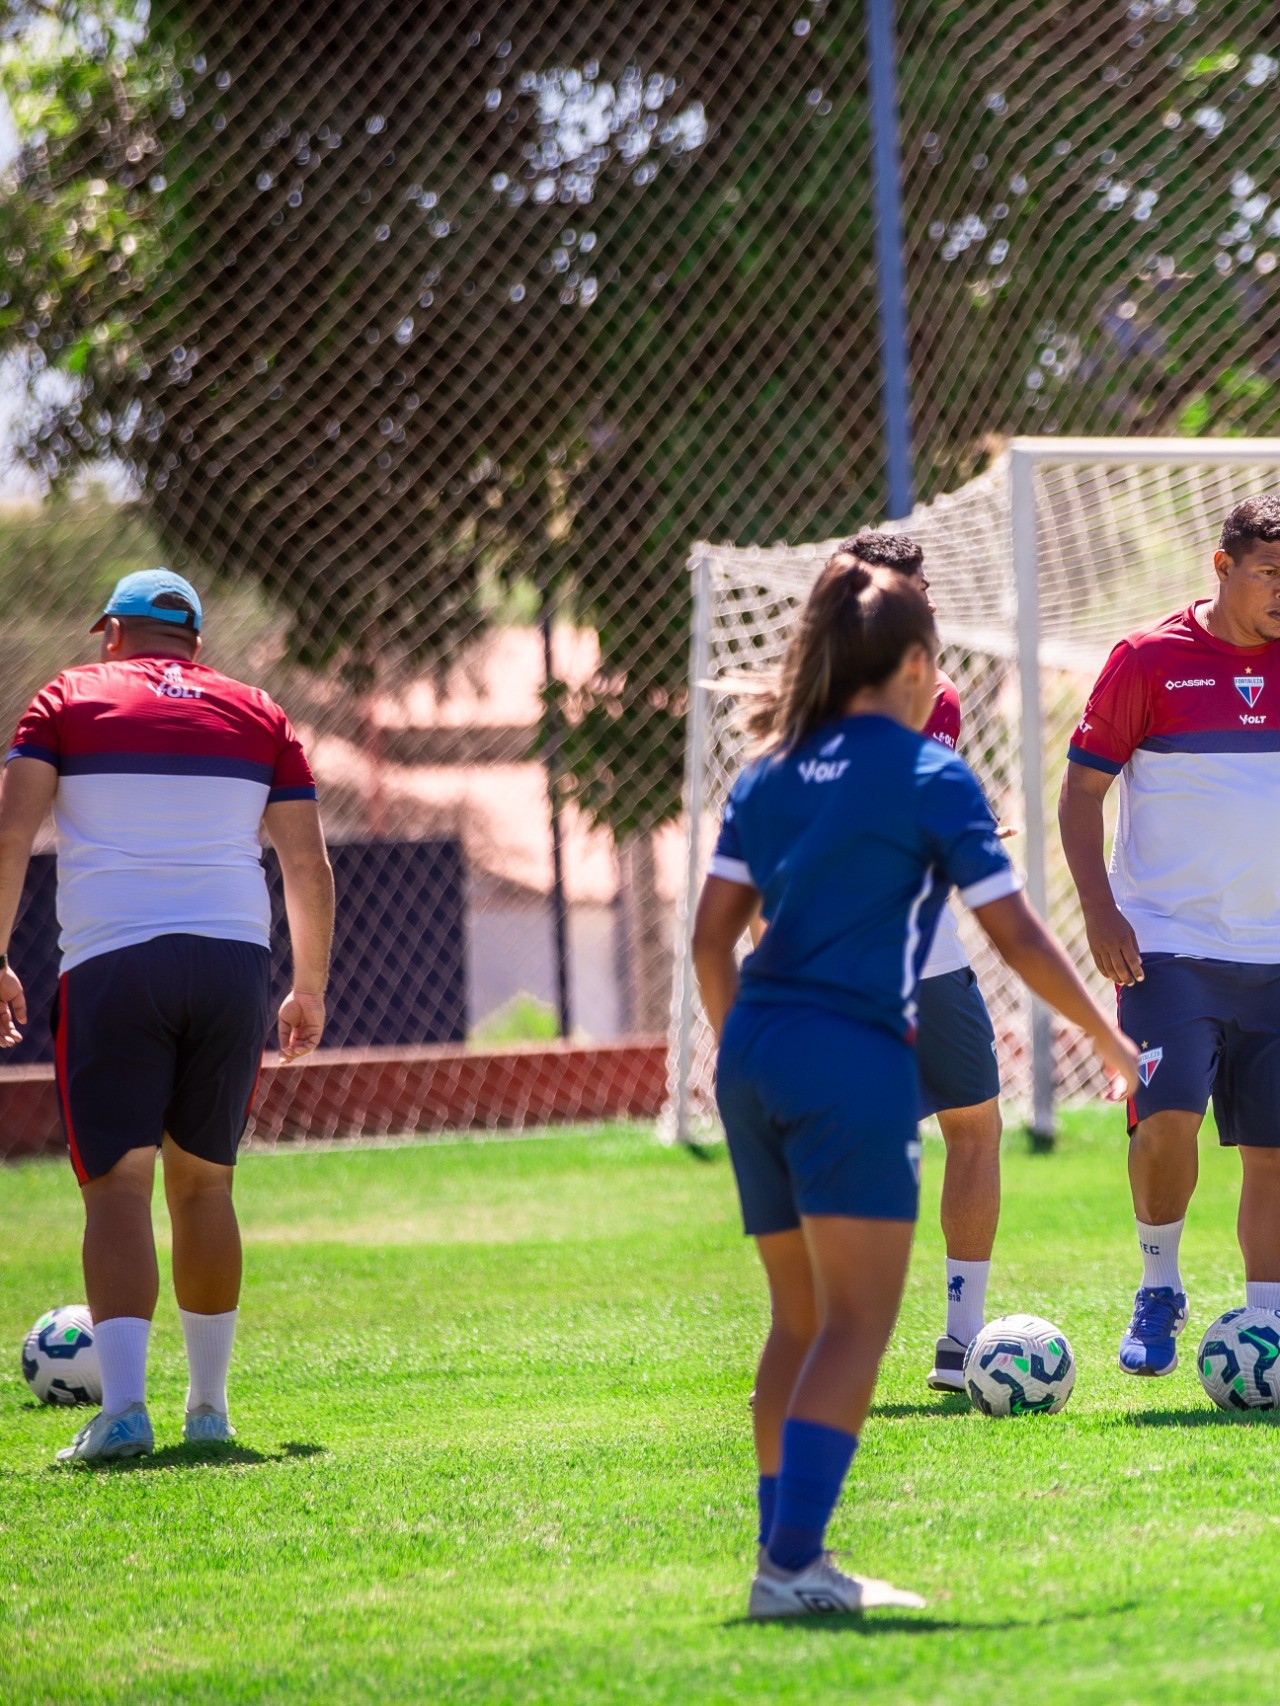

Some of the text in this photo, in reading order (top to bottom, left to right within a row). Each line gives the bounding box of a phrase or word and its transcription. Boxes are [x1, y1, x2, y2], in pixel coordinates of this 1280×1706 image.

[145, 682, 205, 698] VOLT
[1174, 679, 1216, 688] CASSINO
[1239, 714, 1267, 725] VOLT
[798, 758, 851, 784] VOLT
[1140, 1241, 1160, 1255] EC
